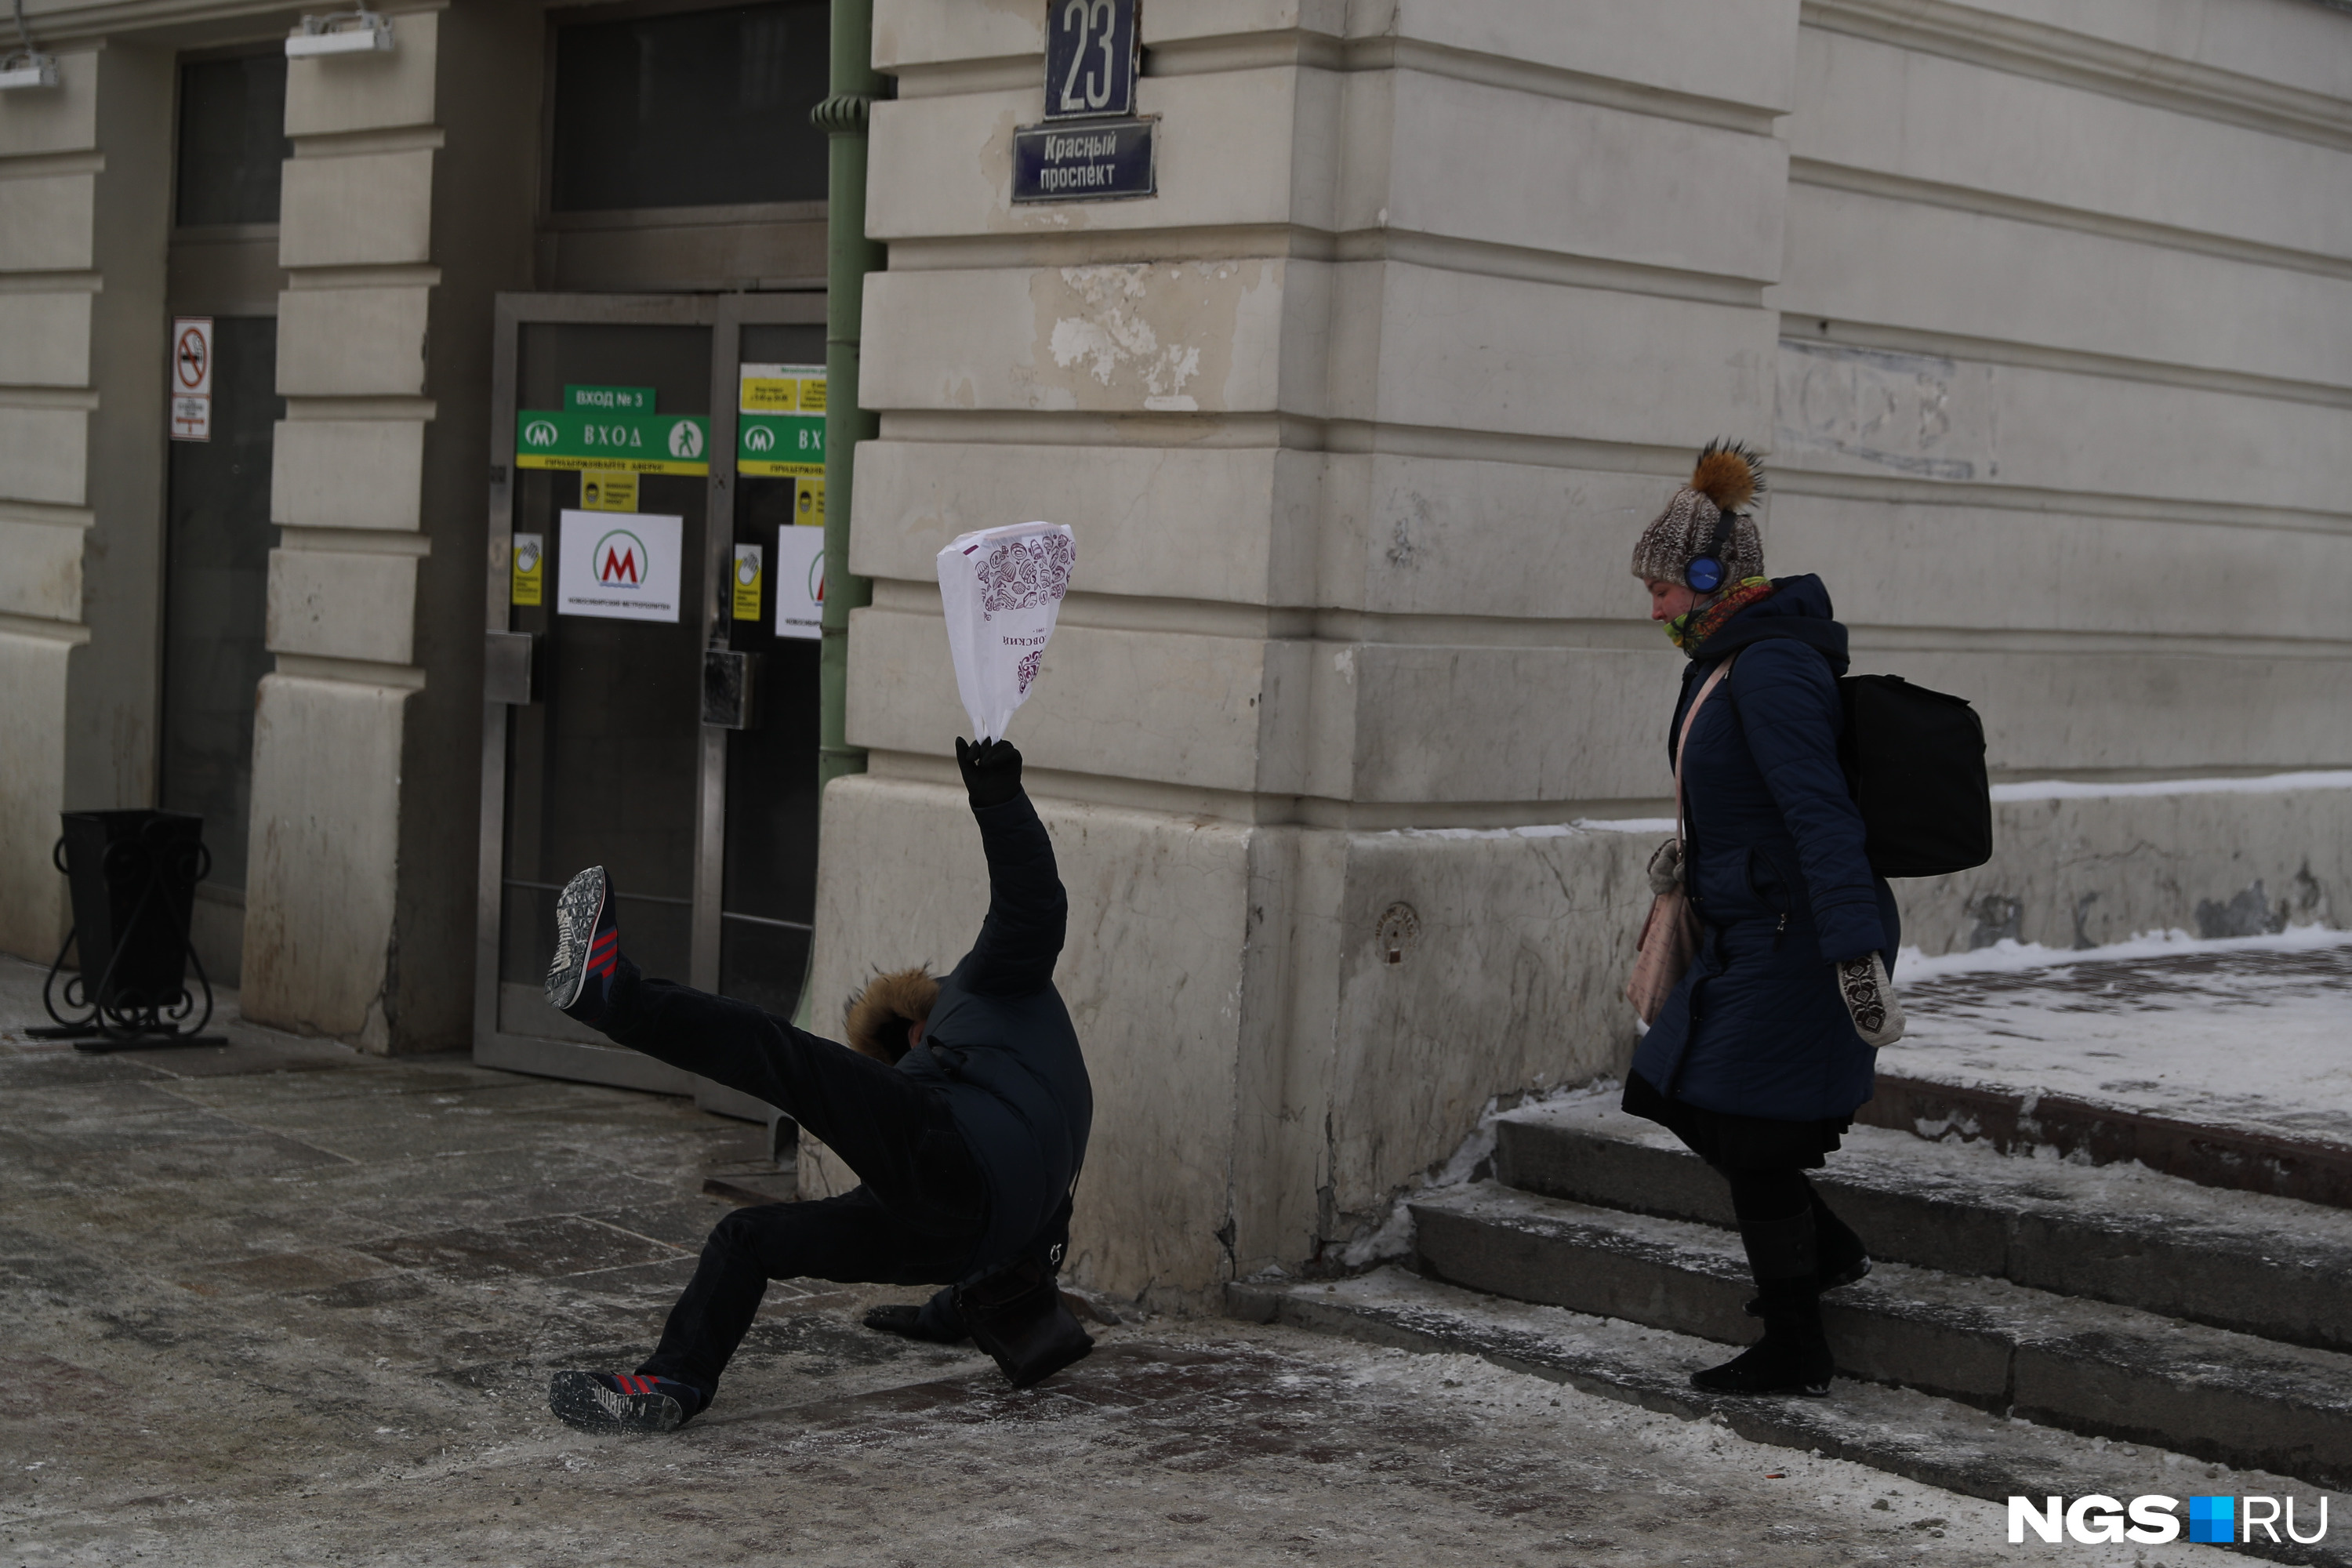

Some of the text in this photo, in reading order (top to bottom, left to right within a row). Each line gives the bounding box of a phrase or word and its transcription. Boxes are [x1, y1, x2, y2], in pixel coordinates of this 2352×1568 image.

[1060, 0, 1116, 111] 23
[1044, 131, 1117, 164] Красный
[1040, 163, 1116, 191] проспект
[576, 390, 614, 408] ВХОД
[634, 392, 643, 408] 3
[584, 424, 642, 448] ВХОД
[799, 428, 825, 450] ВХ
[1003, 635, 1047, 647] ОВСКИЙ
